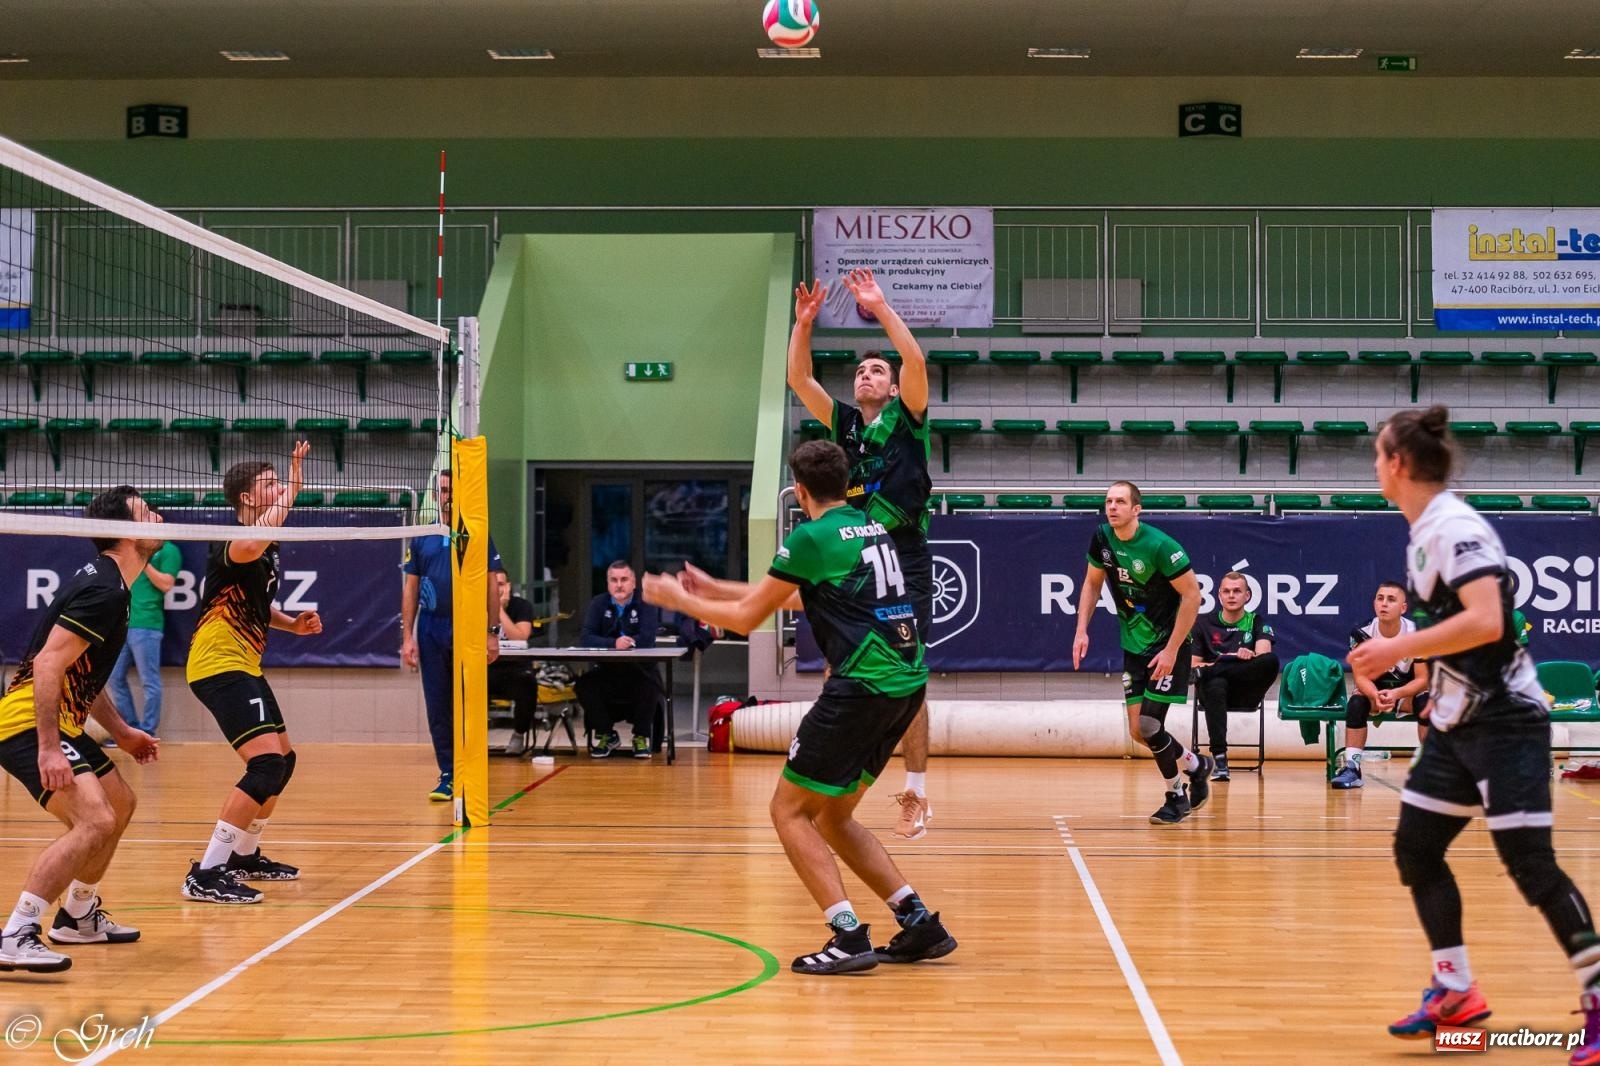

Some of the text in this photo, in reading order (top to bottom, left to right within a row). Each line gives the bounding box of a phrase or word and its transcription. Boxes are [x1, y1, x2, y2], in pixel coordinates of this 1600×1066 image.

[131, 116, 145, 134] B
[159, 115, 180, 134] B
[1184, 113, 1206, 132] C
[1219, 113, 1237, 132] C
[835, 214, 972, 241] MIESZKO
[837, 257, 989, 267] Operator urządzeń cukierniczych
[888, 267, 946, 277] produkcyjny
[1444, 271, 1597, 281] tel. 32 414 92 88, 502 632 695,
[892, 282, 934, 292] Czekamy
[1451, 285, 1488, 294] 47-400
[1490, 284, 1536, 295] Racibórz,
[1538, 284, 1550, 294] ul.
[1552, 285, 1560, 294] J.
[1562, 286, 1582, 294] von
[861, 543, 907, 600] 14
[1117, 567, 1130, 581] 13
[1503, 555, 1600, 612] OSi
[1155, 675, 1173, 692] 13
[249, 697, 264, 722] 7
[1438, 961, 1456, 973] R
